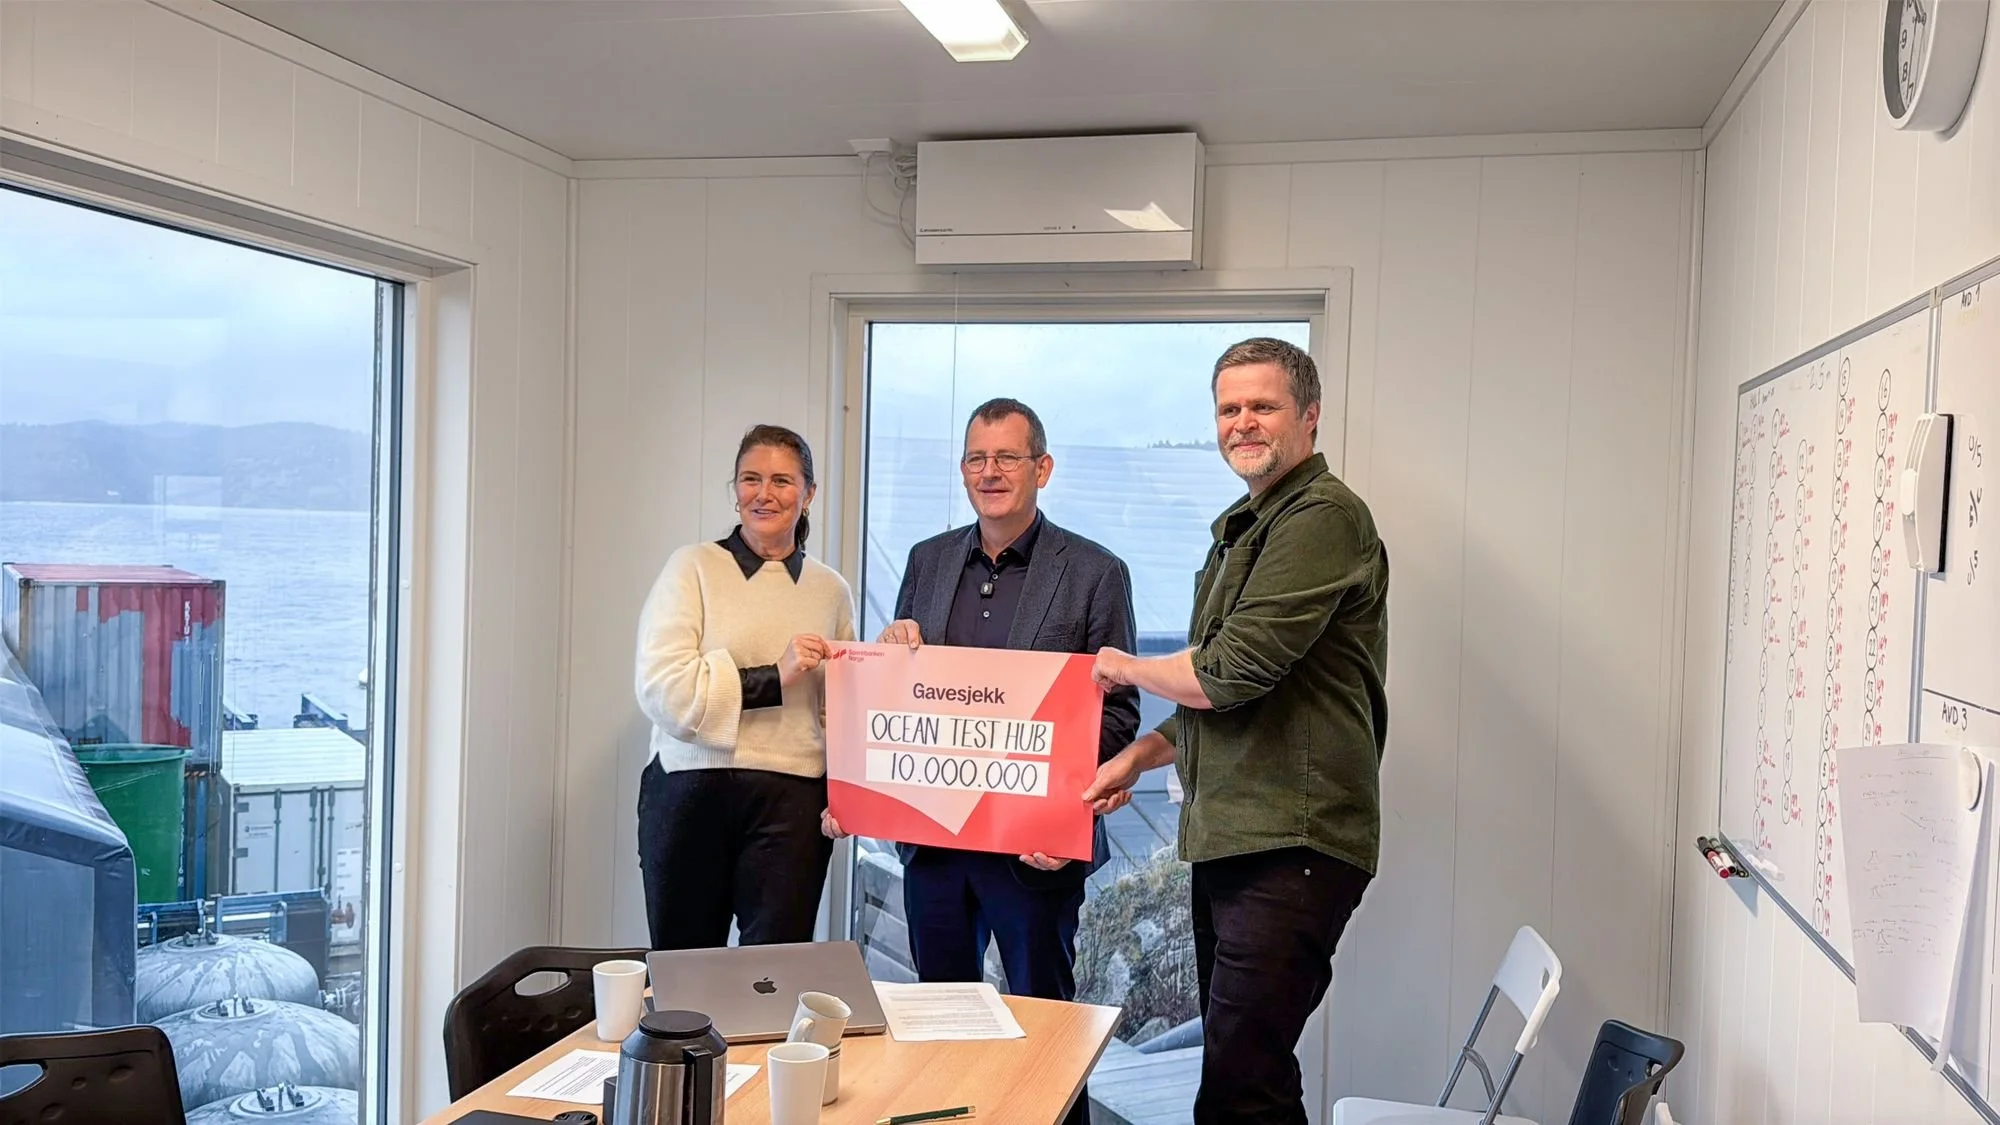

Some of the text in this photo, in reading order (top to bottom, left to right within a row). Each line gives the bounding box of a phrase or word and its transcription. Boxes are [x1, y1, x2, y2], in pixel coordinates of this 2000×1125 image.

[1901, 29, 1908, 49] 9
[1902, 61, 1908, 82] 8
[913, 682, 1006, 706] Gavesjekk
[1941, 701, 1968, 732] AVD 3
[871, 712, 1046, 753] OCEAN TEST HUB
[891, 752, 1037, 793] 10.000.000
